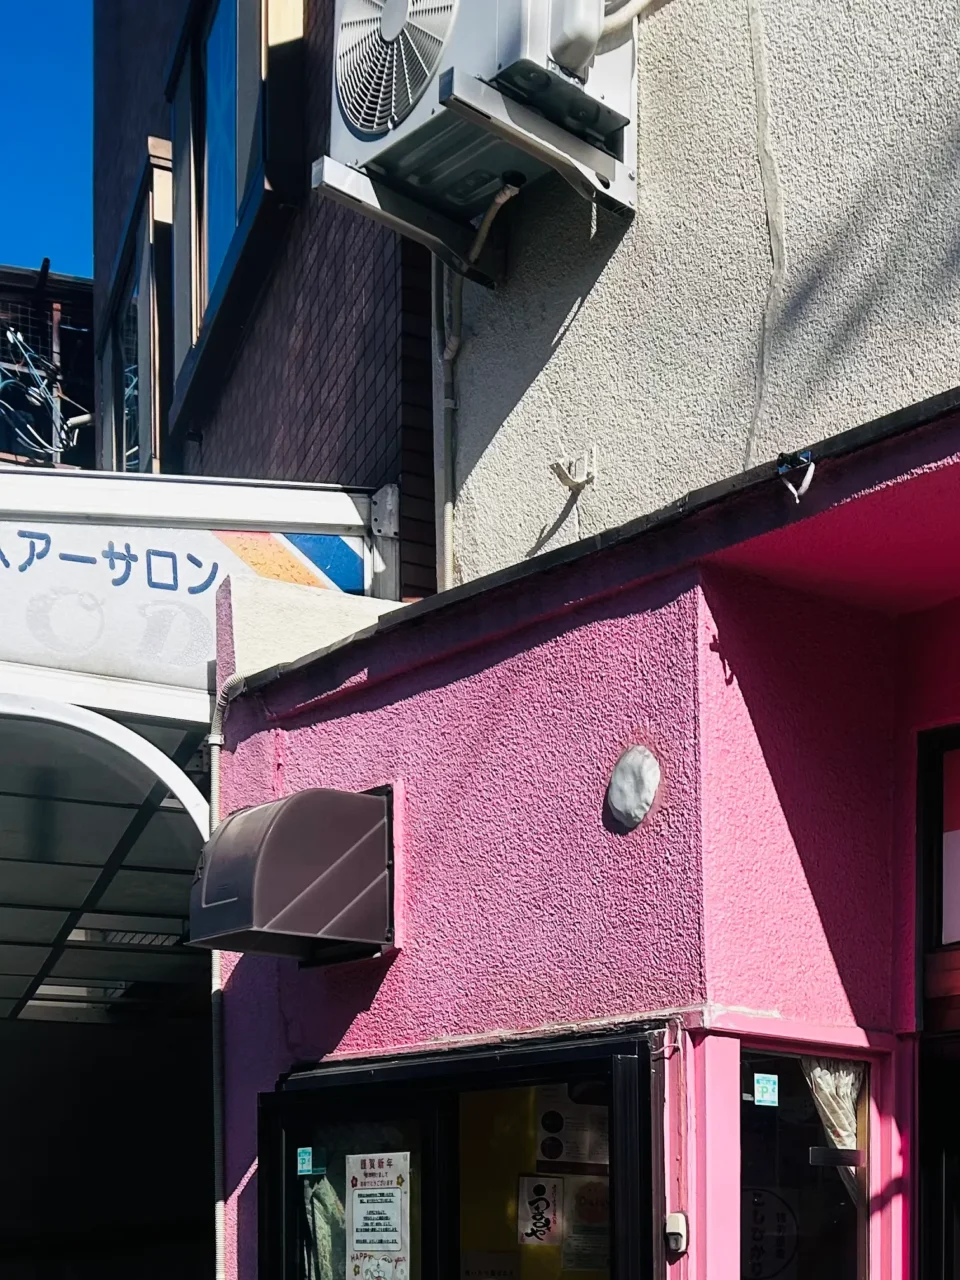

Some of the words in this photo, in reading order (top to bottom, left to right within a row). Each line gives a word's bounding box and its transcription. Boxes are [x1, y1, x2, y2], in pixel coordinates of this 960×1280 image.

[0, 529, 220, 595] アーサロン
